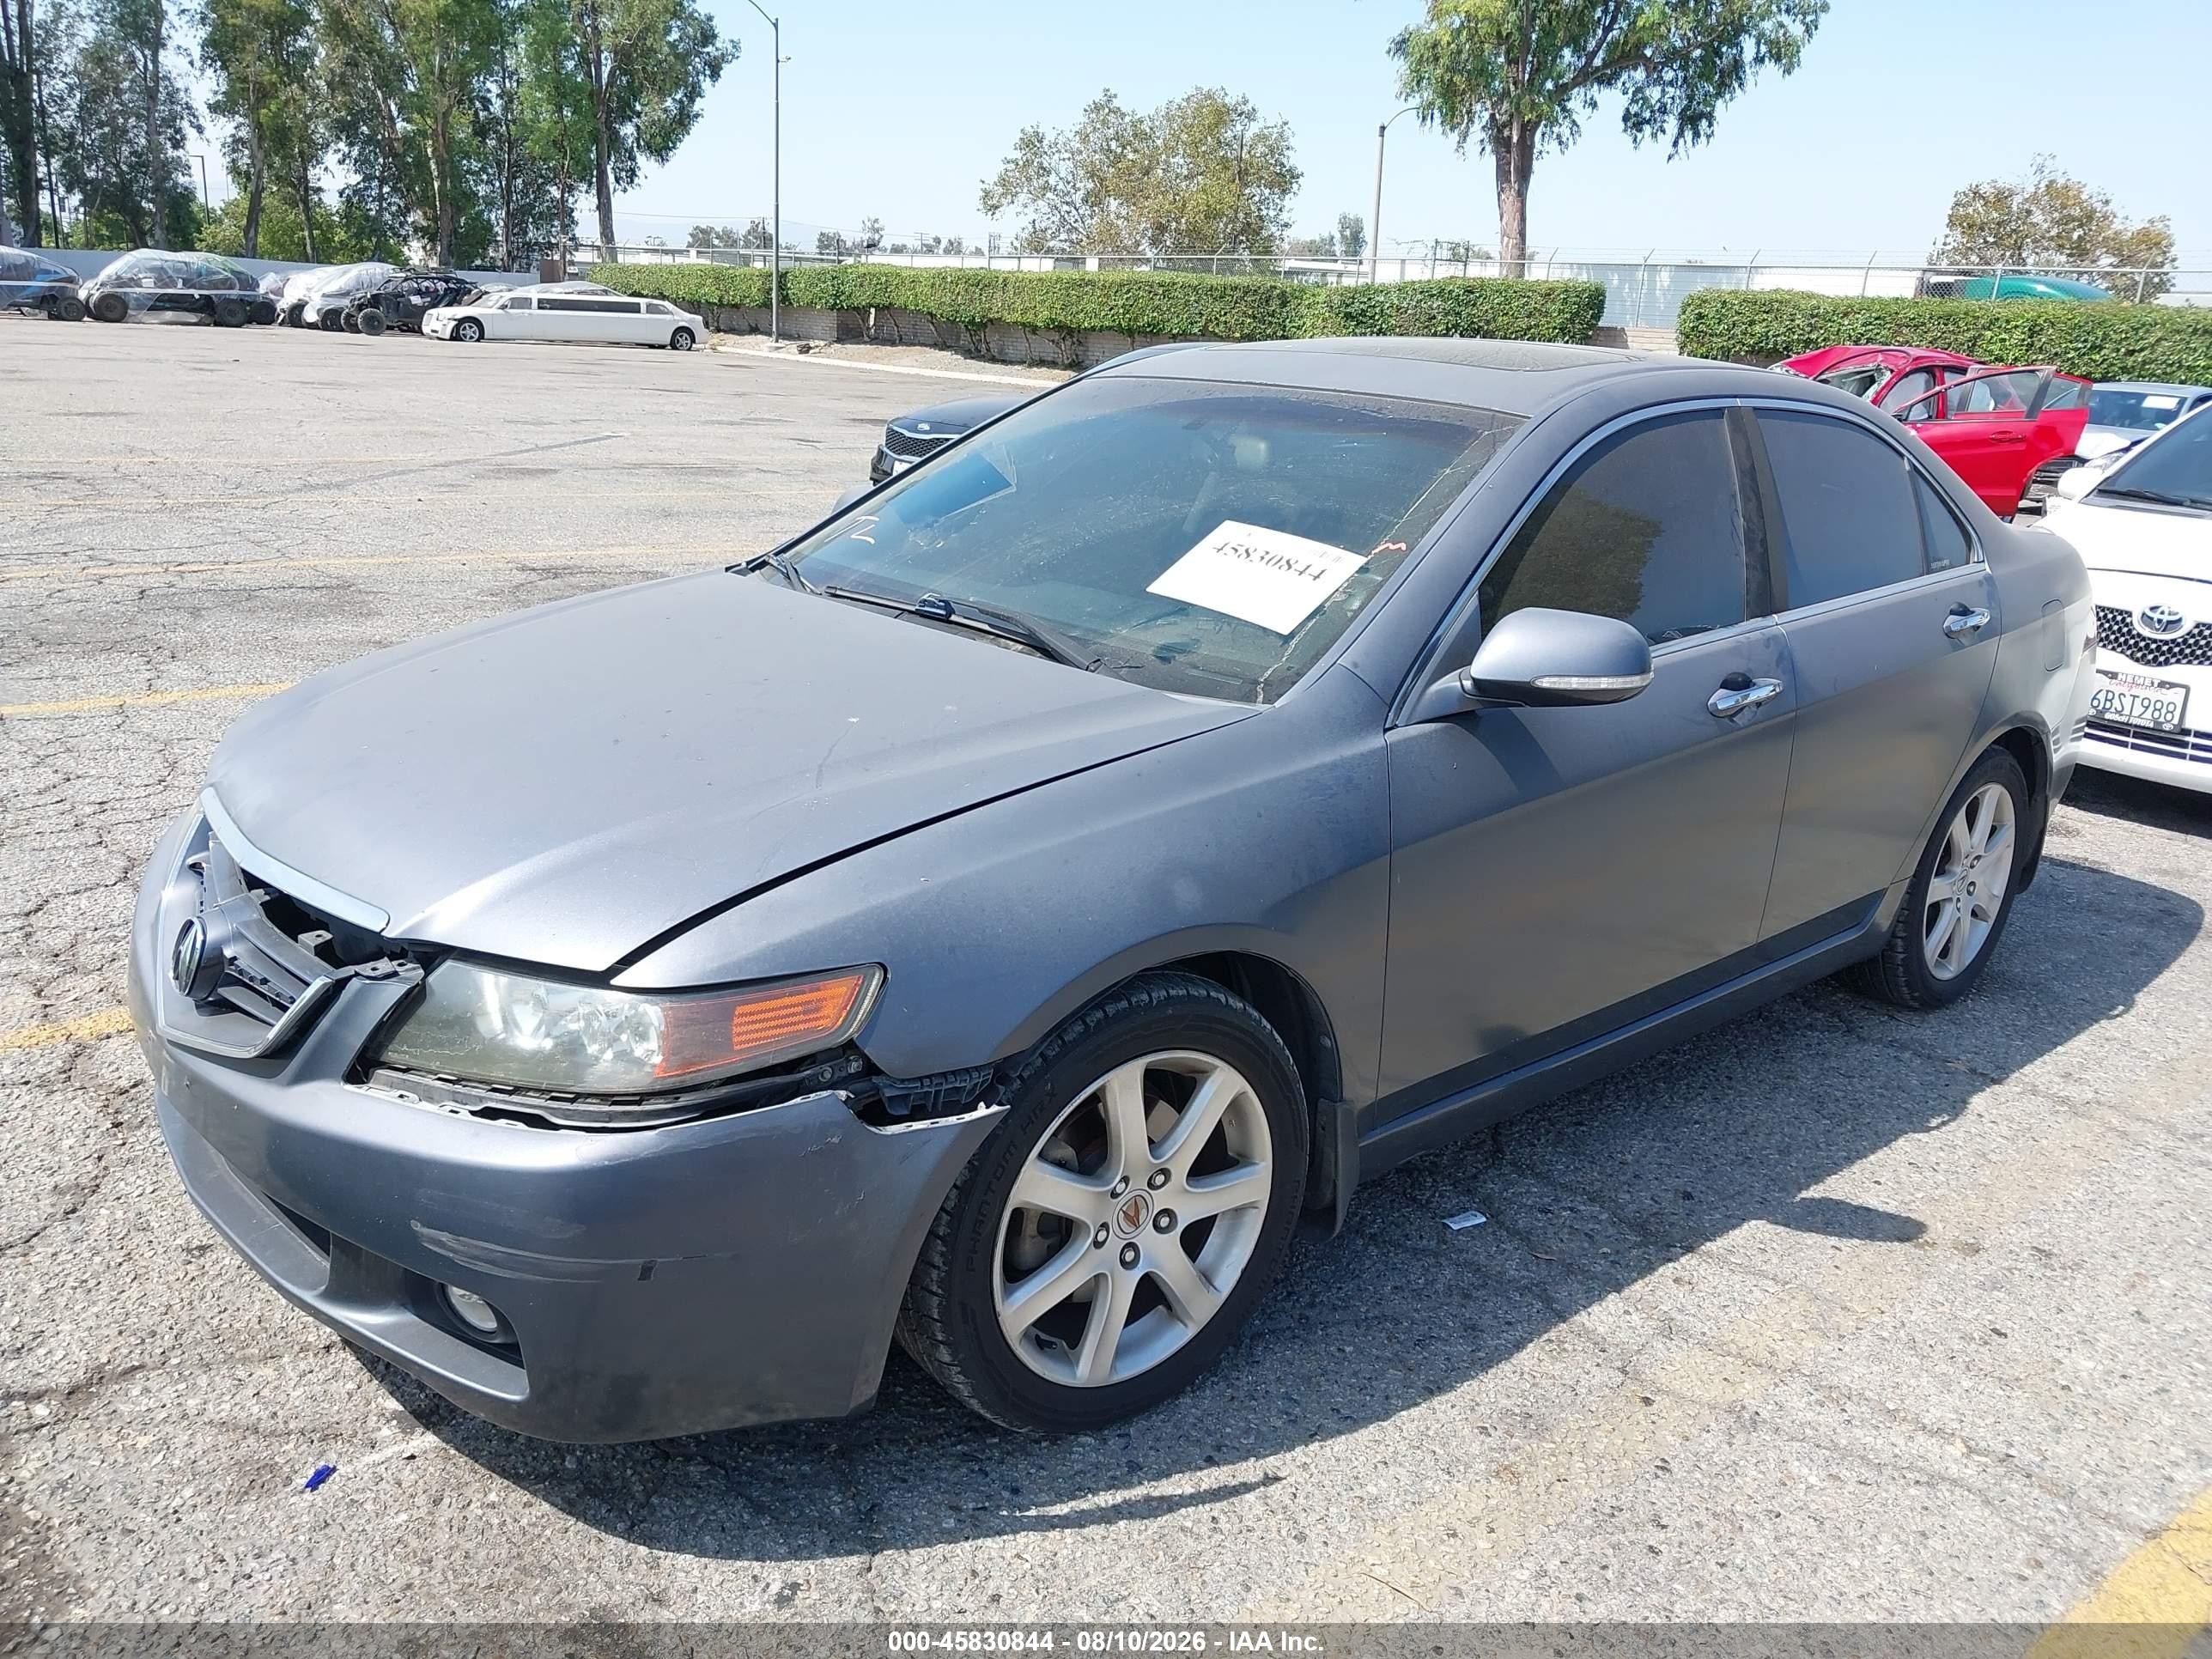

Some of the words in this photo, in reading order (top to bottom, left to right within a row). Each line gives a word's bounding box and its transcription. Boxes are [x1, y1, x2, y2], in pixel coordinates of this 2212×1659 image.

[1212, 541, 1328, 581] 45830844
[2117, 672, 2161, 688] HEMET
[2090, 689, 2177, 723] 6BST988
